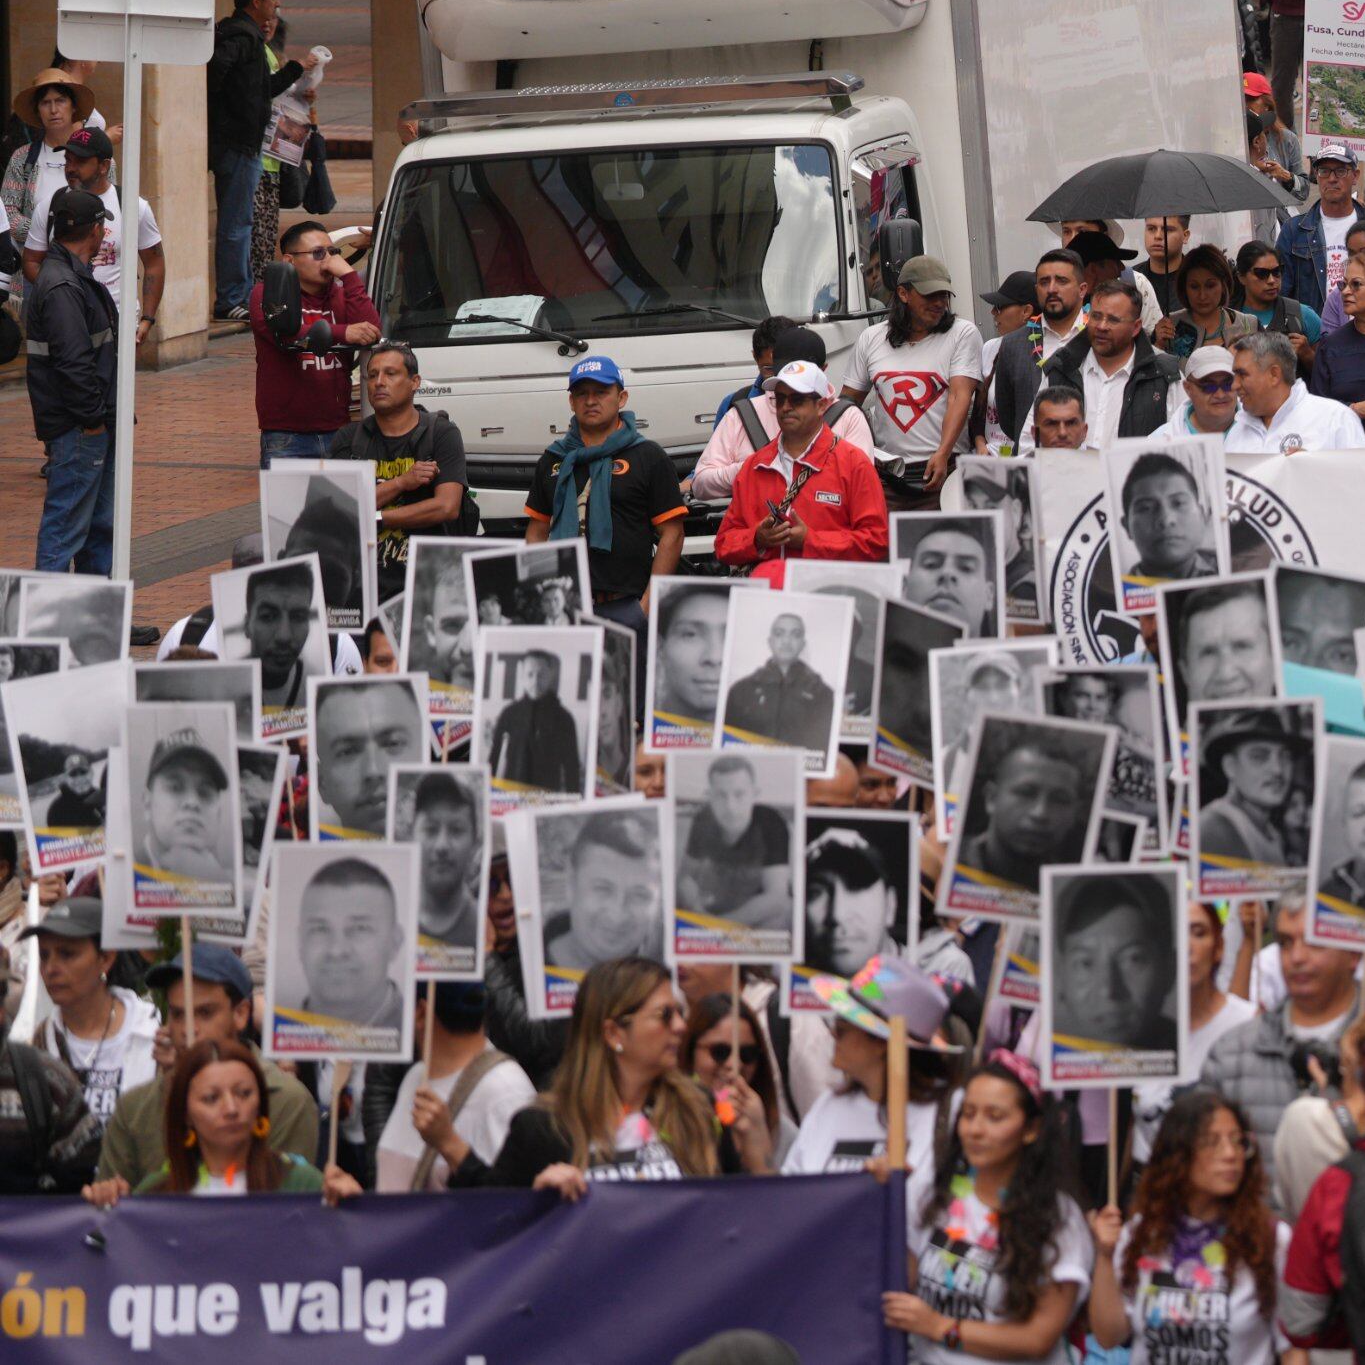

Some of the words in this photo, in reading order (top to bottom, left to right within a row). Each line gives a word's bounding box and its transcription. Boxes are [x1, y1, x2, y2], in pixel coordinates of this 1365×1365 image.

[1307, 25, 1334, 36] Fusa,
[1312, 48, 1333, 56] Fecha
[108, 1283, 240, 1351] que
[260, 1266, 447, 1346] valga
